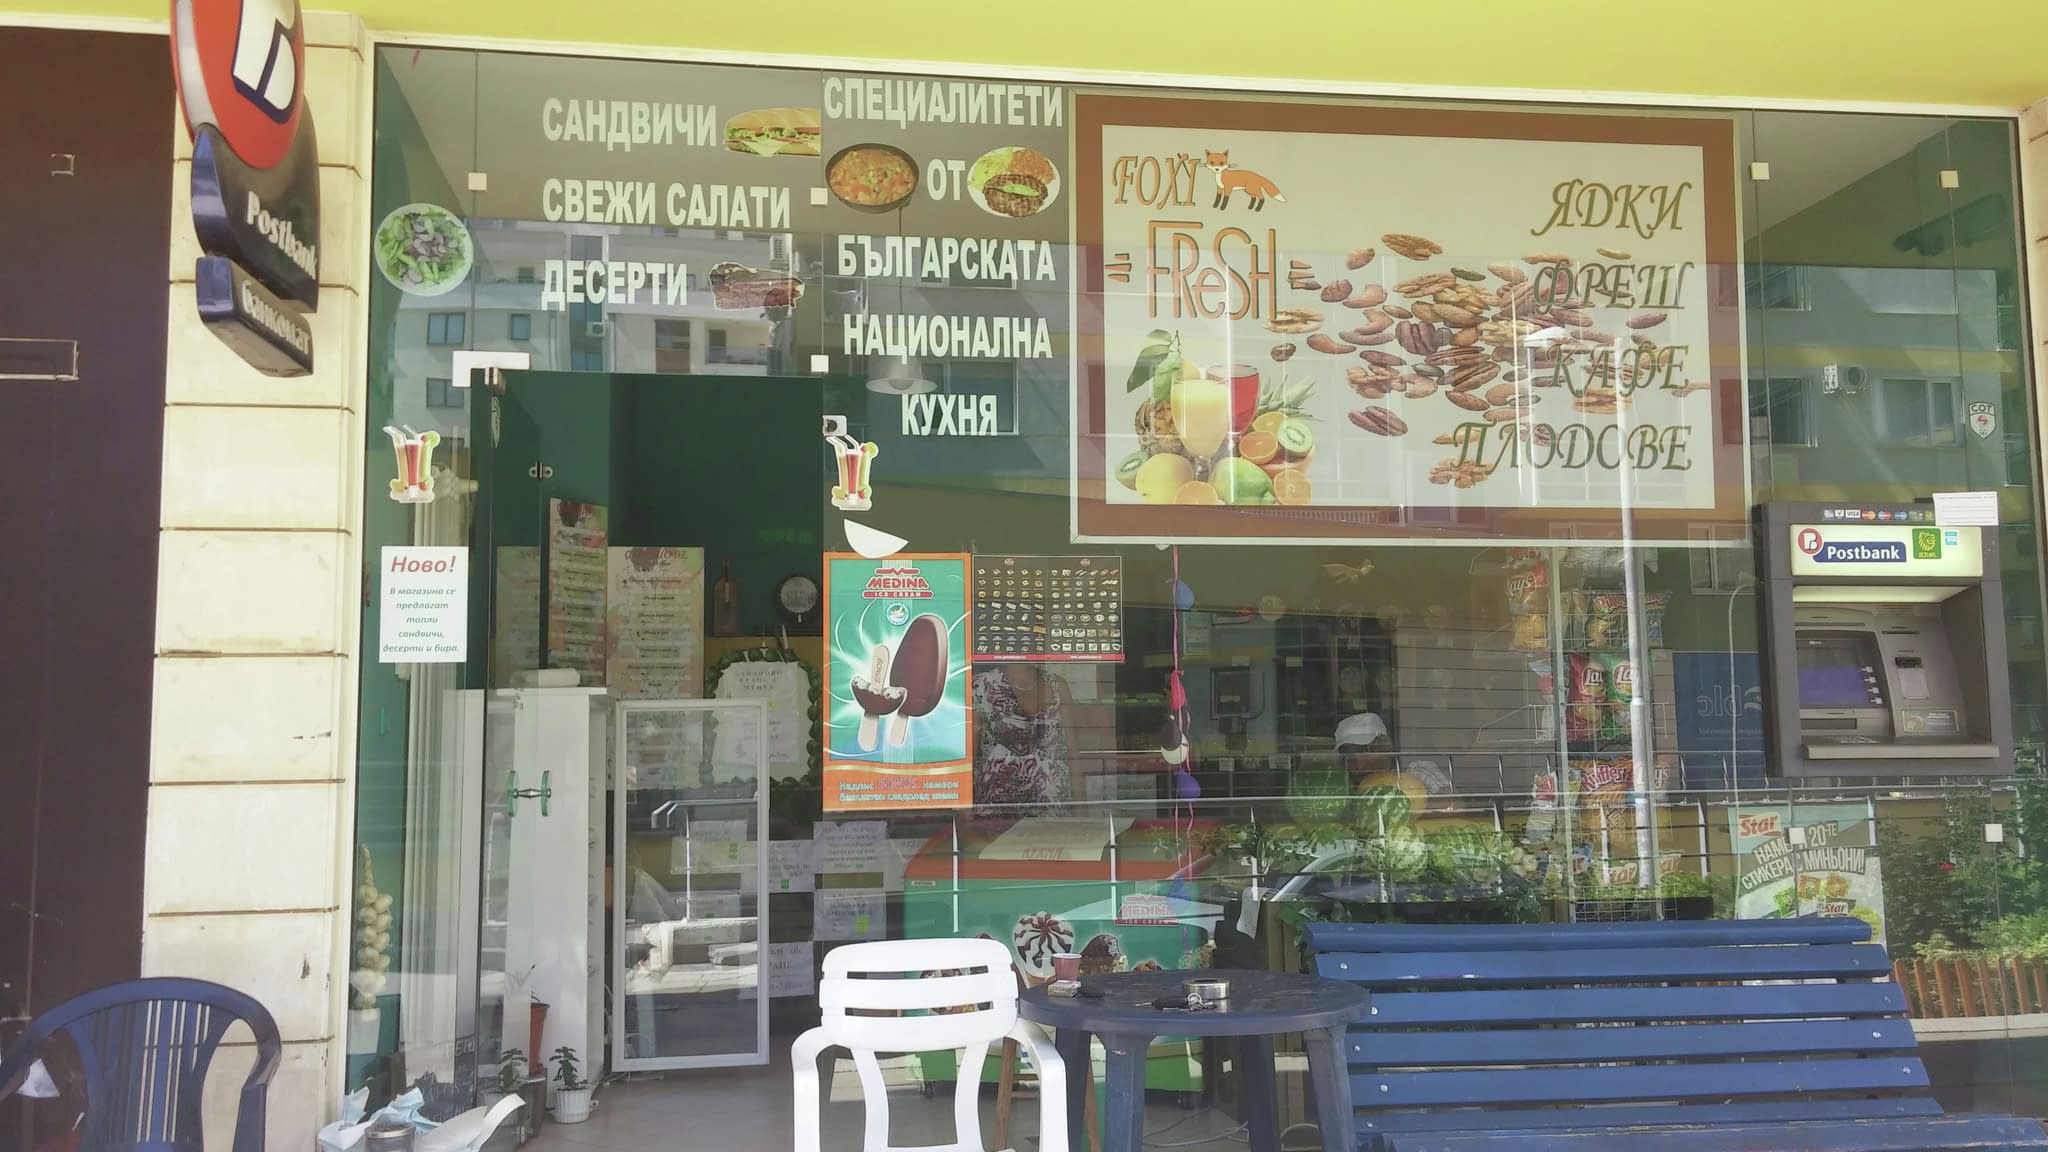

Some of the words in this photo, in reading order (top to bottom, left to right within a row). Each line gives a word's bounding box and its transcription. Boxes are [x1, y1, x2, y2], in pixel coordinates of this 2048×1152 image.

[542, 97, 718, 152] САНДВИЧИ
[823, 76, 1064, 130] СПЕЦИАЛИТЕТИ
[927, 159, 965, 201] ОТ
[542, 179, 657, 225] СВЕЖИ
[667, 182, 791, 229] САЛАТИ
[1531, 178, 1692, 239] ЯДКИ
[246, 191, 318, 280] Postbank
[837, 233, 1058, 282] БЪЛГАРСКАТА
[541, 259, 688, 312] ДЕСЕРТИ
[1533, 259, 1695, 315] ФРЕШ
[843, 313, 1055, 362] НАЦИОНАЛНА
[1547, 343, 1690, 398] КАФЕ
[901, 393, 998, 436] КУХНЯ
[1451, 419, 1693, 476] ПЛОДОВЕ
[391, 555, 457, 573] Ново!
[1827, 545, 1900, 560] Postbank
[389, 587, 396, 595] В
[398, 588, 444, 596] магазина
[867, 578, 929, 588] MEDINA
[395, 601, 449, 610] предлагат
[383, 644, 424, 653] десерти
[434, 643, 460, 653] бира.
[398, 630, 445, 638] сандвичи,
[1741, 815, 1778, 837] Star
[1808, 821, 1839, 847] 20-ТЕ
[1741, 855, 1795, 890] СТИКЕРА
[1803, 847, 1865, 873] МИНЬОНИ!
[1824, 903, 1847, 912] Star
